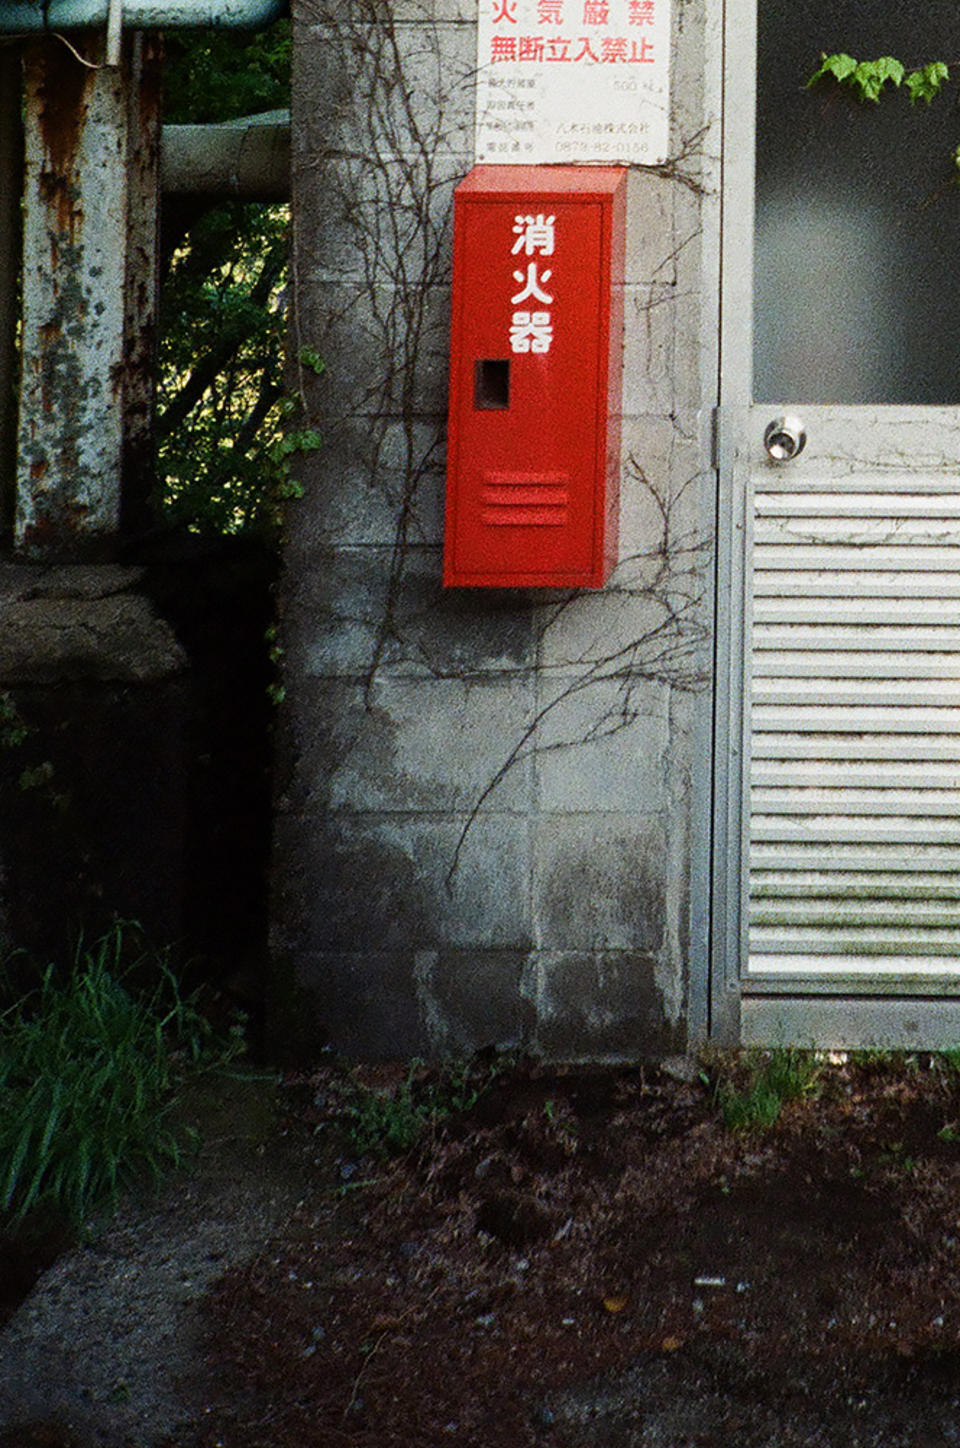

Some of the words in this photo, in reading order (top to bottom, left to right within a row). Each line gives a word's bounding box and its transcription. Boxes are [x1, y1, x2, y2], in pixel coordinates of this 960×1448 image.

[492, 0, 655, 26] 火気厳禁
[490, 35, 655, 64] 無断立入禁止
[509, 213, 556, 353] 消火器
